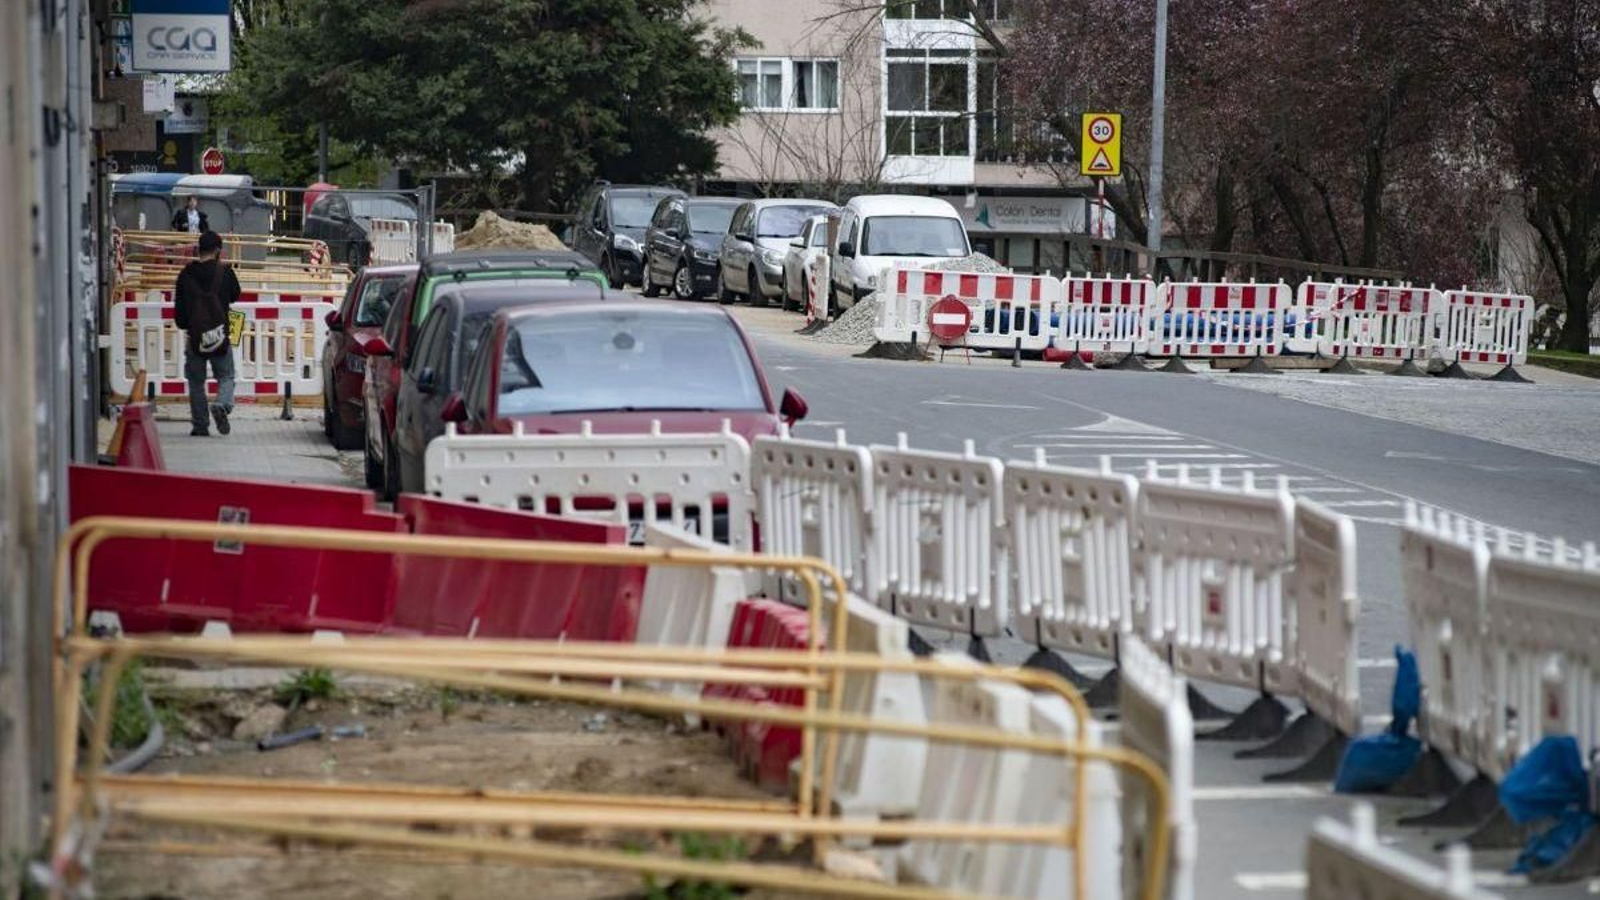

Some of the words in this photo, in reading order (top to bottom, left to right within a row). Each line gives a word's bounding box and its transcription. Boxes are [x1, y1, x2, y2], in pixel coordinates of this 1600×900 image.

[1094, 125, 1110, 136] 30
[204, 159, 222, 168] STOP
[1030, 204, 1062, 217] Dental
